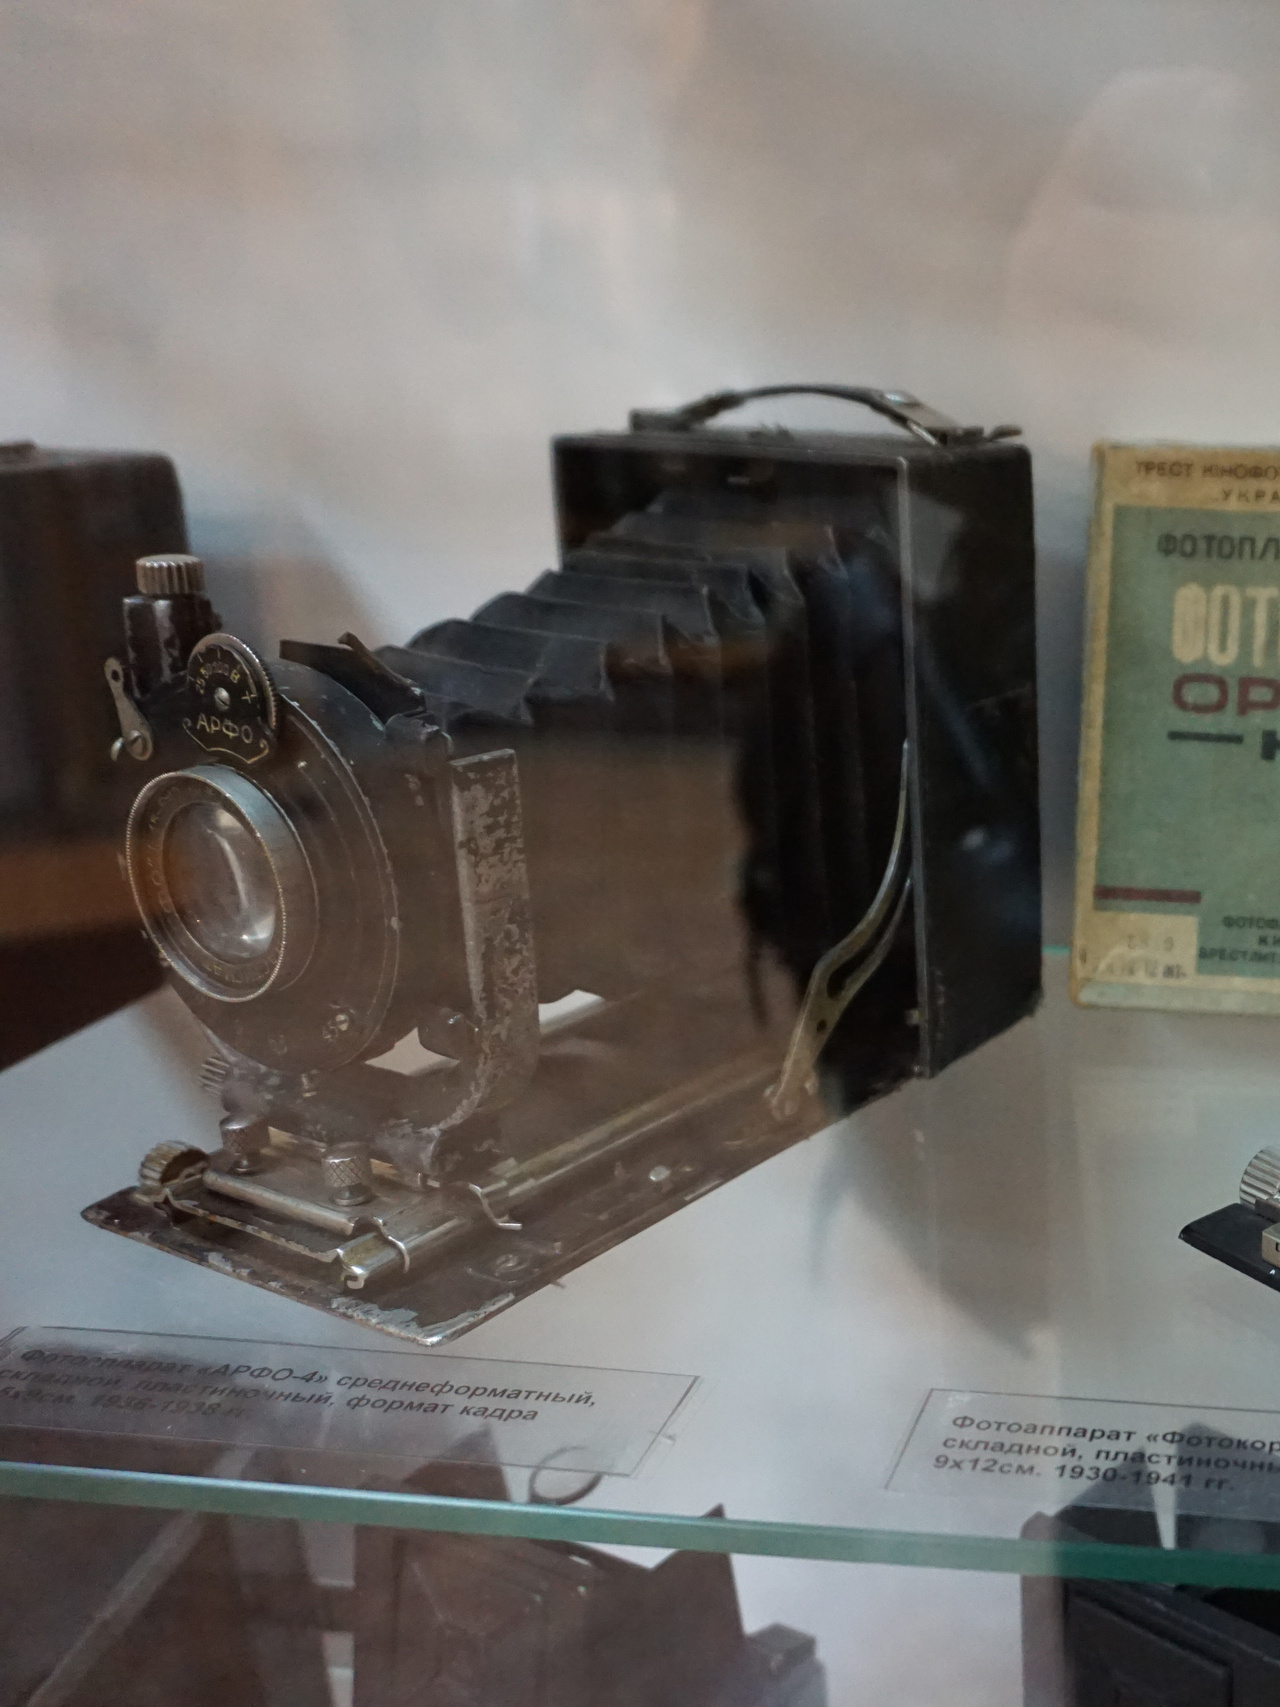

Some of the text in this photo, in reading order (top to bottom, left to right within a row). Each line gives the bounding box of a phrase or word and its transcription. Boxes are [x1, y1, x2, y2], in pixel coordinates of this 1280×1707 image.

[196, 712, 254, 744] АРФО
[335, 1374, 597, 1410] среднеформатный,
[345, 1394, 456, 1420] формат
[459, 1405, 540, 1423] кадра
[952, 1413, 1139, 1444] Фотоаппарат
[942, 1434, 1085, 1464] складной,
[1054, 1465, 1194, 1492] 1930-1941
[1203, 1478, 1236, 1493] гг.
